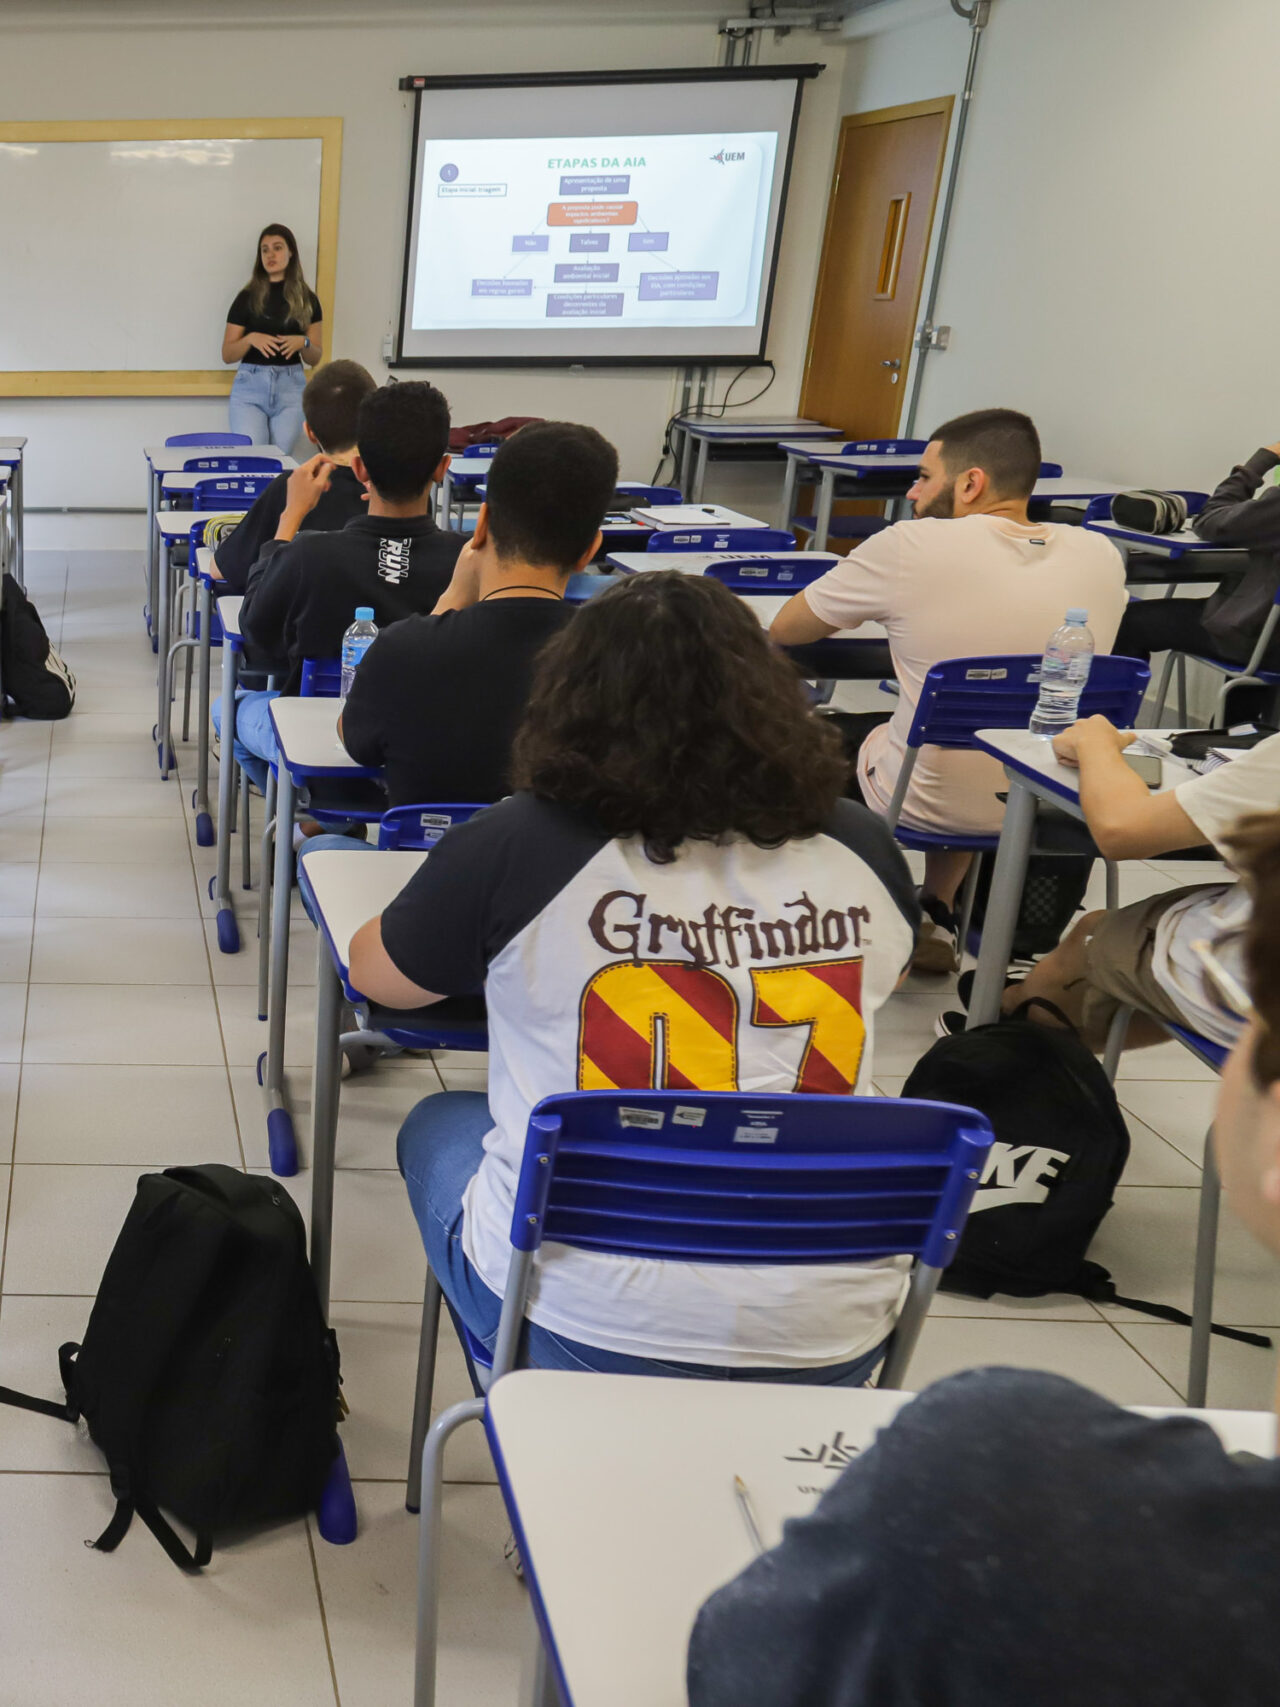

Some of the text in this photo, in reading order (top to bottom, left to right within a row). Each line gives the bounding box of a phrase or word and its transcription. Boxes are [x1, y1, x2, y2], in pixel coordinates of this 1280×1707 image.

[547, 156, 647, 169] ETAPAS DA AIA
[725, 152, 746, 161] UEM
[385, 540, 403, 584] RUN
[588, 890, 870, 970] Gryffindor
[978, 1141, 1071, 1203] KE
